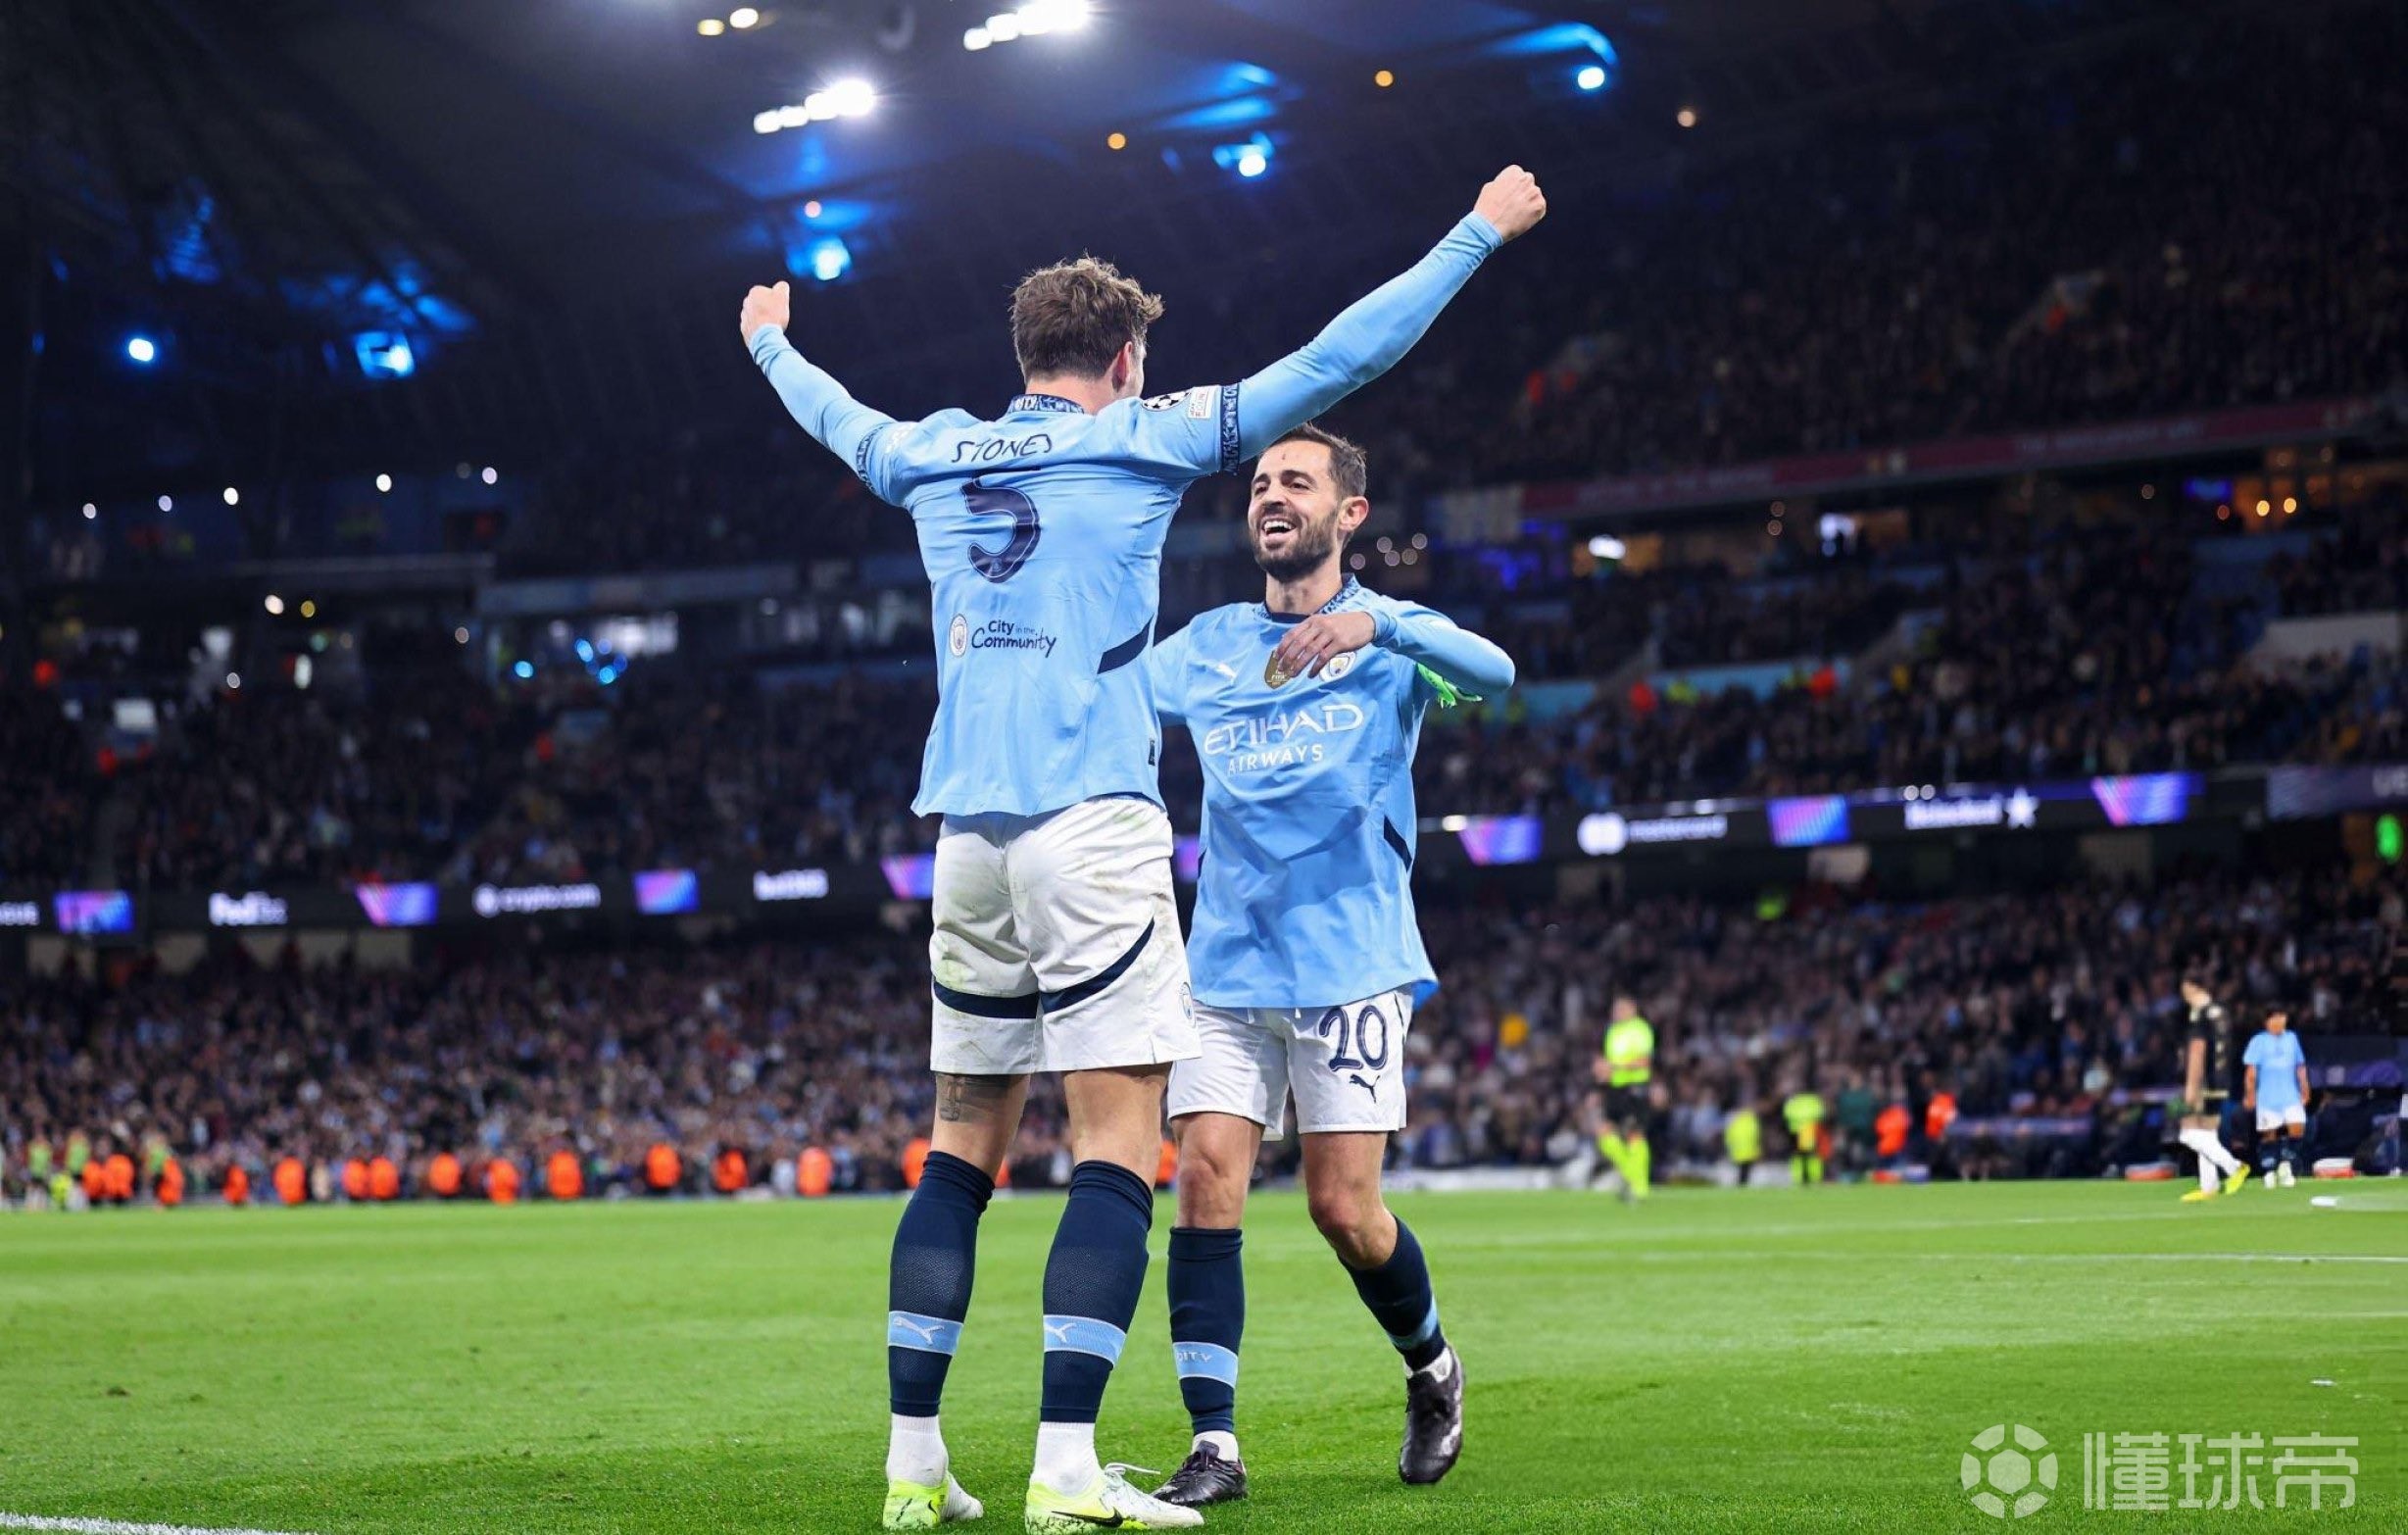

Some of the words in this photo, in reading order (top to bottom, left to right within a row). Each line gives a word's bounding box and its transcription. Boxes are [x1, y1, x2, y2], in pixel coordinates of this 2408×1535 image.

[952, 433, 1052, 464] STONES
[959, 468, 1041, 583] 5
[971, 627, 1057, 658] Community
[988, 619, 1014, 635] City
[1204, 704, 1364, 756] ETIHAD
[1228, 743, 1323, 775] AIRWAYS
[1319, 1005, 1388, 1071] 20
